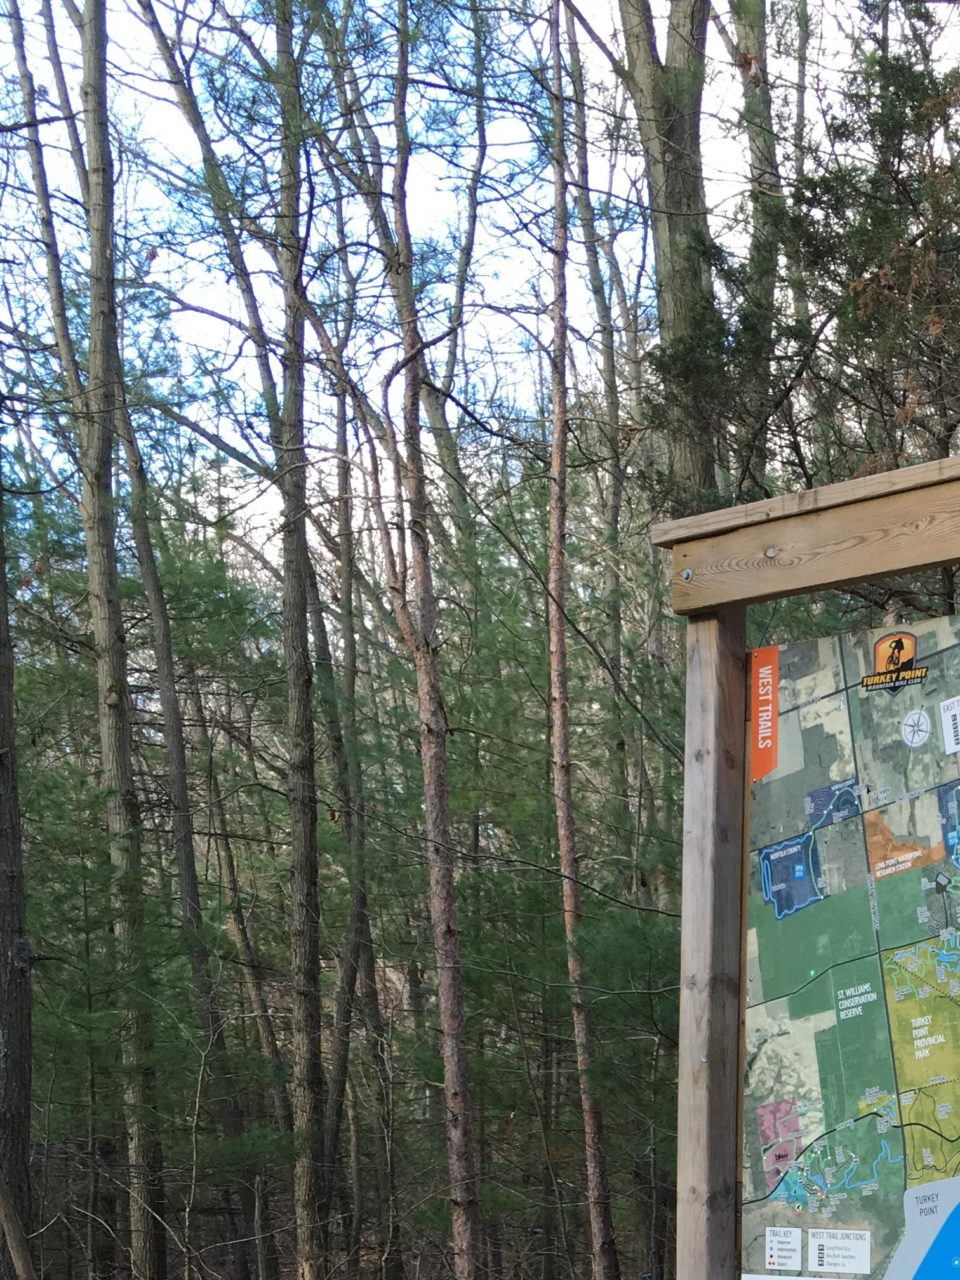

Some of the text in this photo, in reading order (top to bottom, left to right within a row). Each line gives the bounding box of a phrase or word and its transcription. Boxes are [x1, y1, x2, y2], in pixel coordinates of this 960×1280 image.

[863, 667, 928, 686] TURKEY POINT
[758, 664, 773, 749] WEST TRAILS
[943, 702, 956, 713] EAST
[787, 845, 802, 855] COUNTY
[837, 982, 872, 1000] ST. WILLIAMS
[838, 992, 878, 1010] CONSERVATION
[840, 1006, 863, 1020] RESERVE
[911, 1014, 932, 1028] TURKEY
[912, 1027, 929, 1039] POINT
[914, 1034, 946, 1049] PROVINCIAL
[915, 1048, 930, 1060] PARK
[915, 1192, 940, 1205] TURKEY
[919, 1206, 938, 1217] POINT
[770, 1229, 792, 1238] TRAIL KEY
[811, 1231, 867, 1241] WEST TRAIL JUNCTIONS
